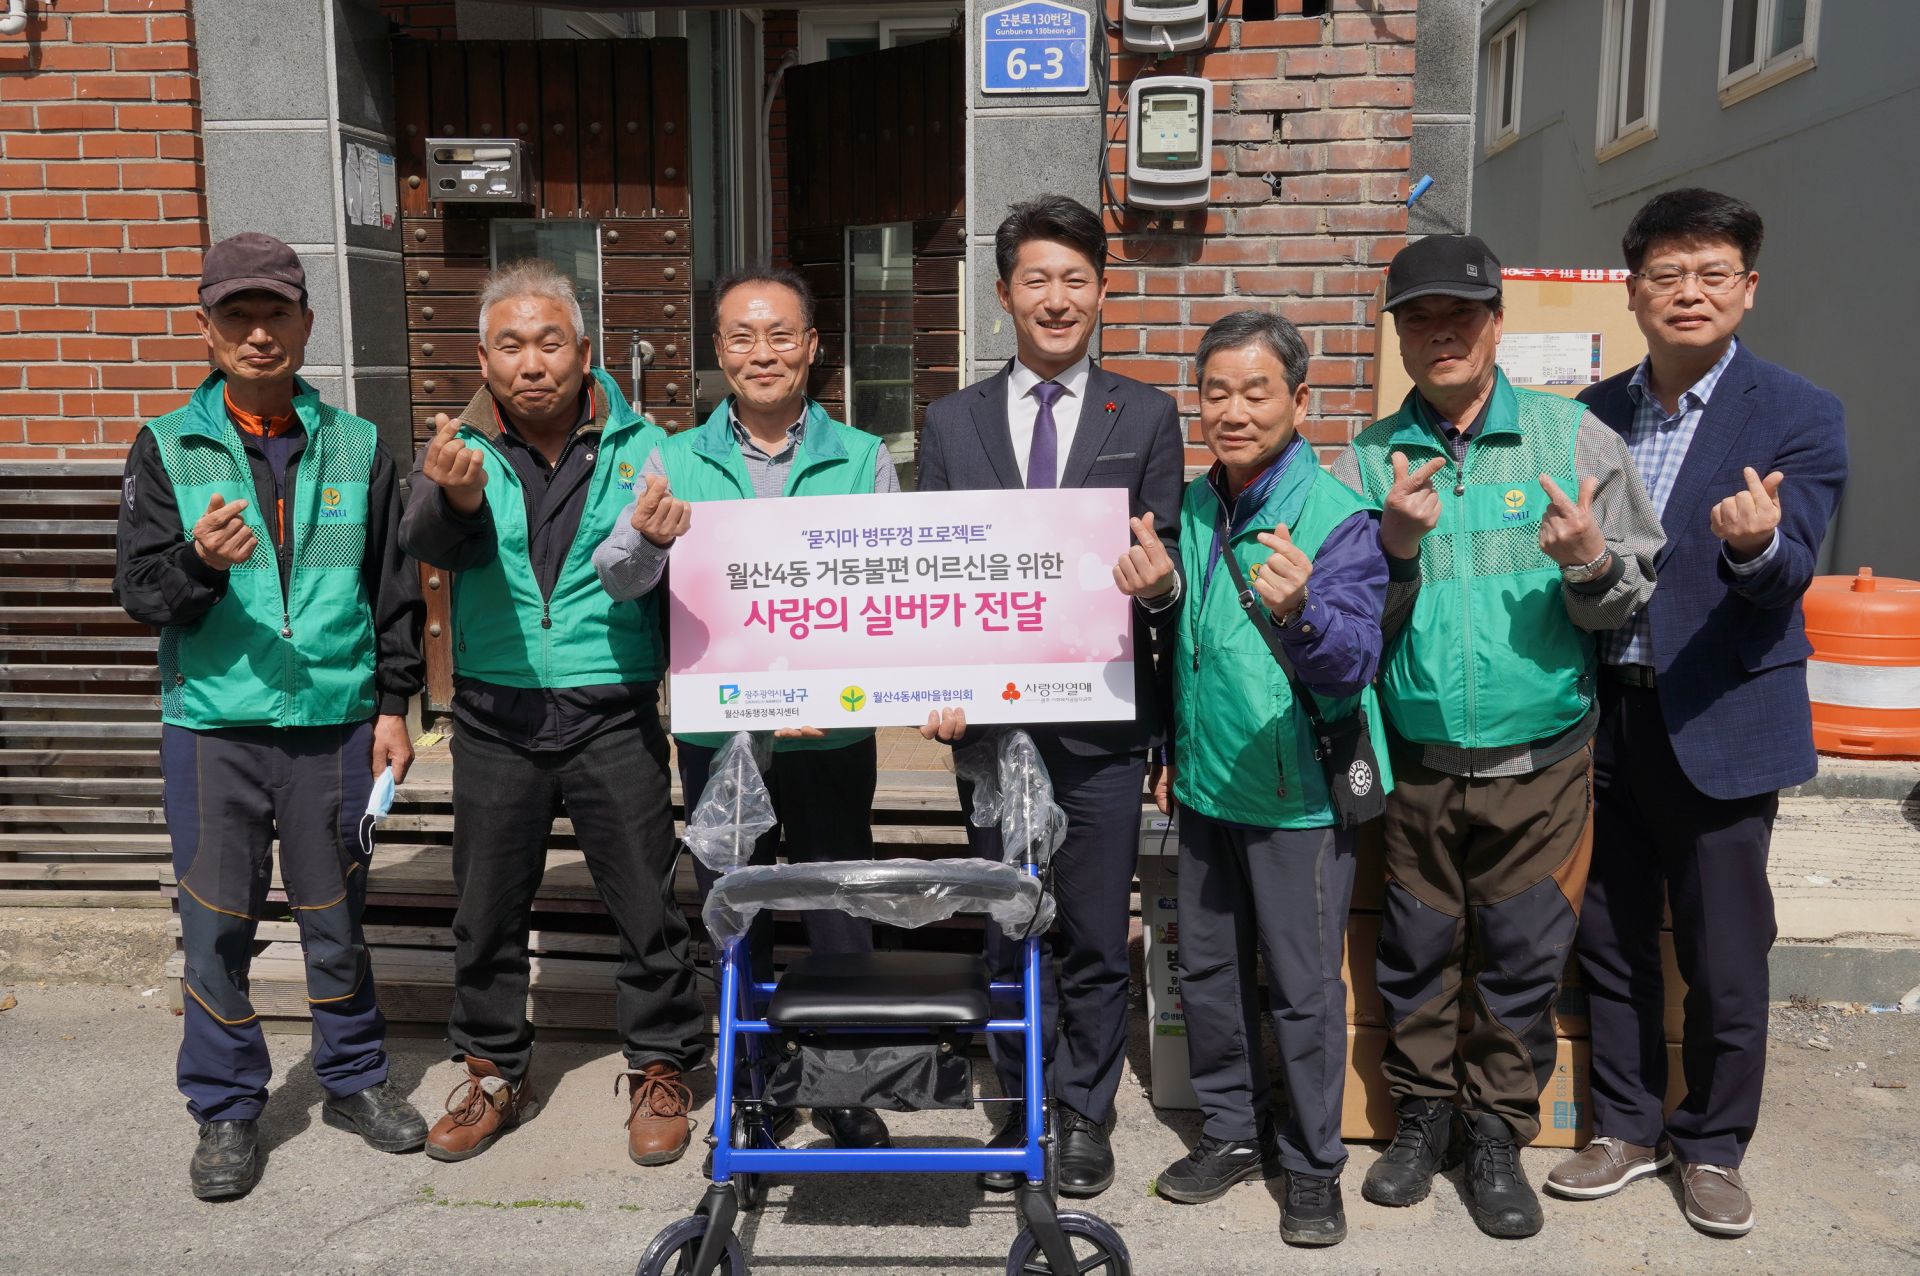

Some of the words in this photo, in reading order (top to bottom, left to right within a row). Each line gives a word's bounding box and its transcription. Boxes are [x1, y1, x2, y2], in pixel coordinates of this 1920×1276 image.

[1000, 13, 1072, 27] 군분로130번길
[995, 28, 1033, 36] Gunbun-ro
[1035, 27, 1076, 37] 130beon-gil
[1006, 47, 1064, 80] 6-3
[320, 509, 347, 518] SMU
[1502, 510, 1530, 522] SMU
[862, 525, 913, 548] 병뚜껑
[916, 523, 993, 546] 프로젝트”
[725, 560, 811, 590] 월산4동
[816, 555, 910, 585] 거동불편
[915, 553, 1012, 583] 어르신을
[1016, 551, 1065, 580] 위한
[743, 596, 849, 640] 사랑의
[858, 592, 967, 637] 실버카
[974, 590, 1048, 633] 전달
[782, 688, 809, 702] 남구
[872, 689, 973, 703] 월산4동새마을협의회
[1024, 681, 1092, 698] 사랑의열매
[724, 707, 800, 719] 월산4동행정복지센터
